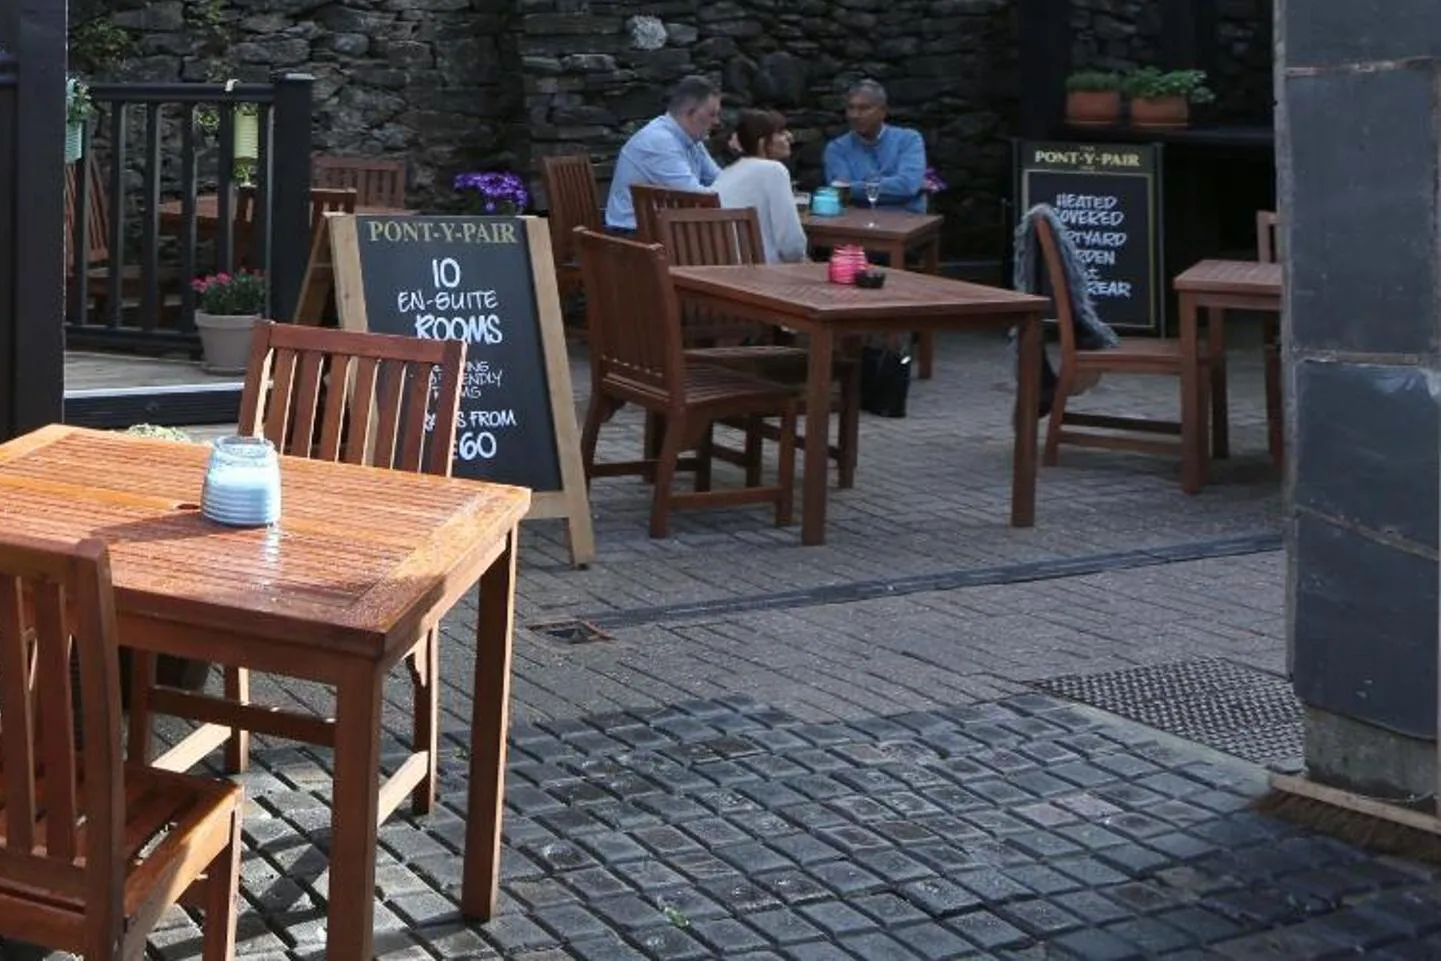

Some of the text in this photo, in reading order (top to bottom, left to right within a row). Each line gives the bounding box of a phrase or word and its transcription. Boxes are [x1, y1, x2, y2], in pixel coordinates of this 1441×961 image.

[1056, 193, 1118, 210] HEATED
[1057, 209, 1125, 226] OVERED
[368, 220, 518, 244] PONT-Y-PAIR
[432, 257, 461, 289] 10
[397, 289, 500, 313] EN-SUITE
[415, 313, 503, 345] ROOMS
[469, 409, 518, 428] FROM
